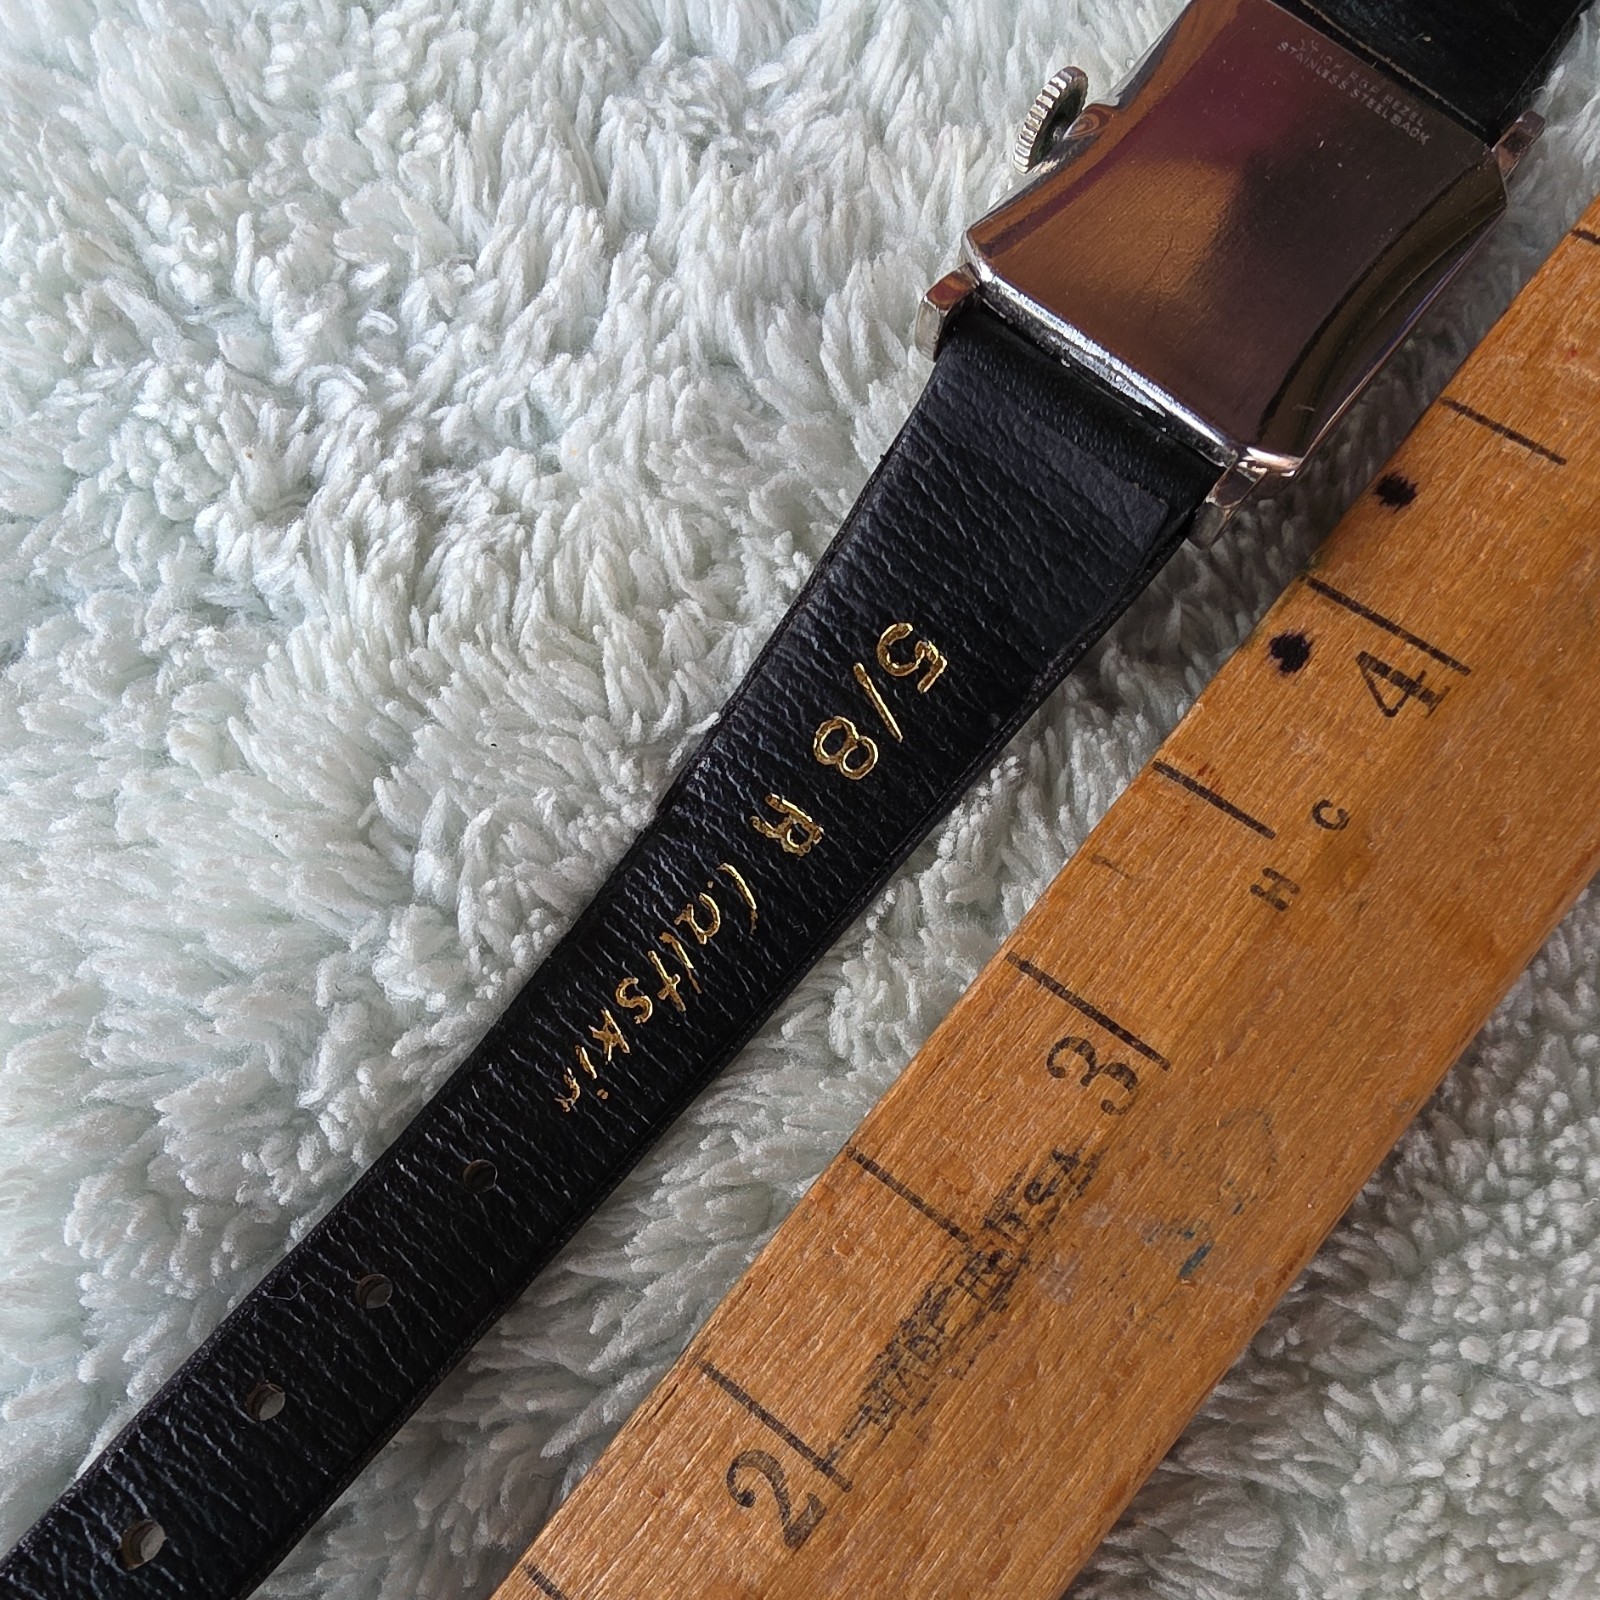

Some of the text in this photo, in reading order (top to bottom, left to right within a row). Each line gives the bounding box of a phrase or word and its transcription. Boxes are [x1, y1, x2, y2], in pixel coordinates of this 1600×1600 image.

[1277, 41, 1348, 90] STAINLESS
[1350, 88, 1389, 119] STEEL
[1390, 115, 1430, 145] BACK
[1382, 94, 1425, 127] BEZEL
[813, 622, 948, 780] 5/8
[1355, 650, 1450, 720] 4
[752, 793, 824, 857] R
[1250, 799, 1350, 912] H C
[1046, 1034, 1140, 1116] 3
[725, 1448, 828, 1552] 2
